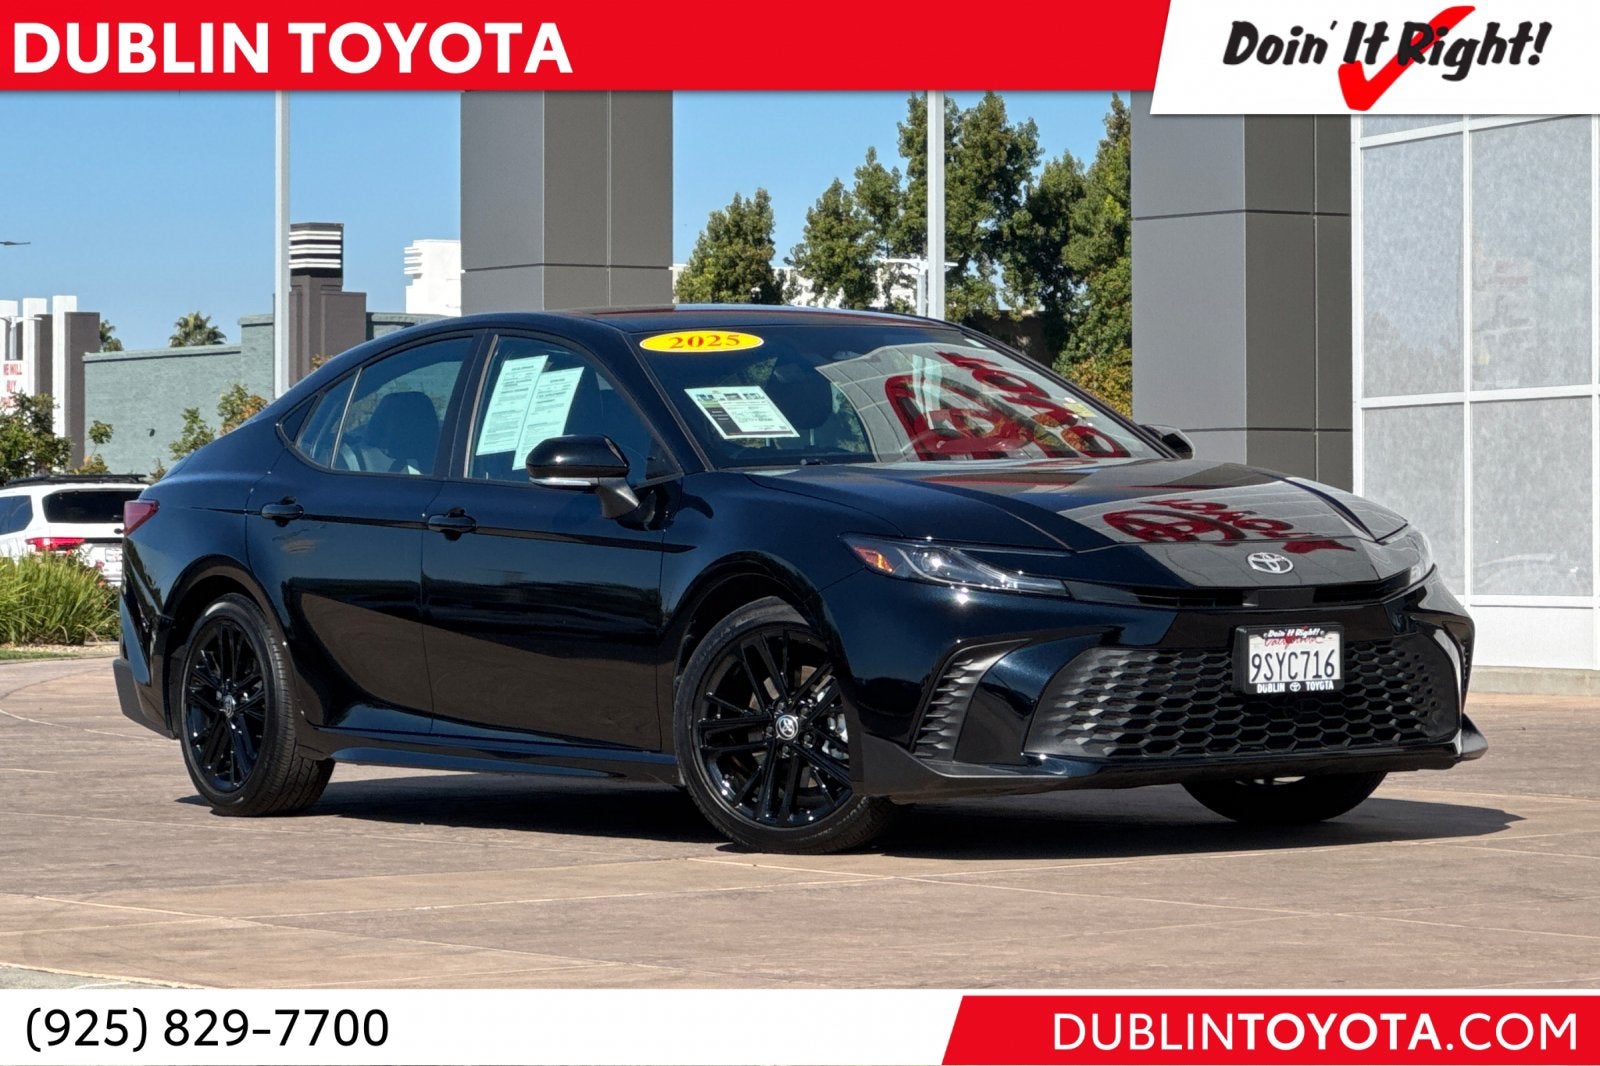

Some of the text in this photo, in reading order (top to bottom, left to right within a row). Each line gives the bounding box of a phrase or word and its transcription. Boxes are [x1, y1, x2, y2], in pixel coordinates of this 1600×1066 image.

[669, 335, 740, 349] 2025
[1251, 649, 1335, 682] 9SYC716
[1256, 680, 1335, 694] DUBLIN TOYOTA
